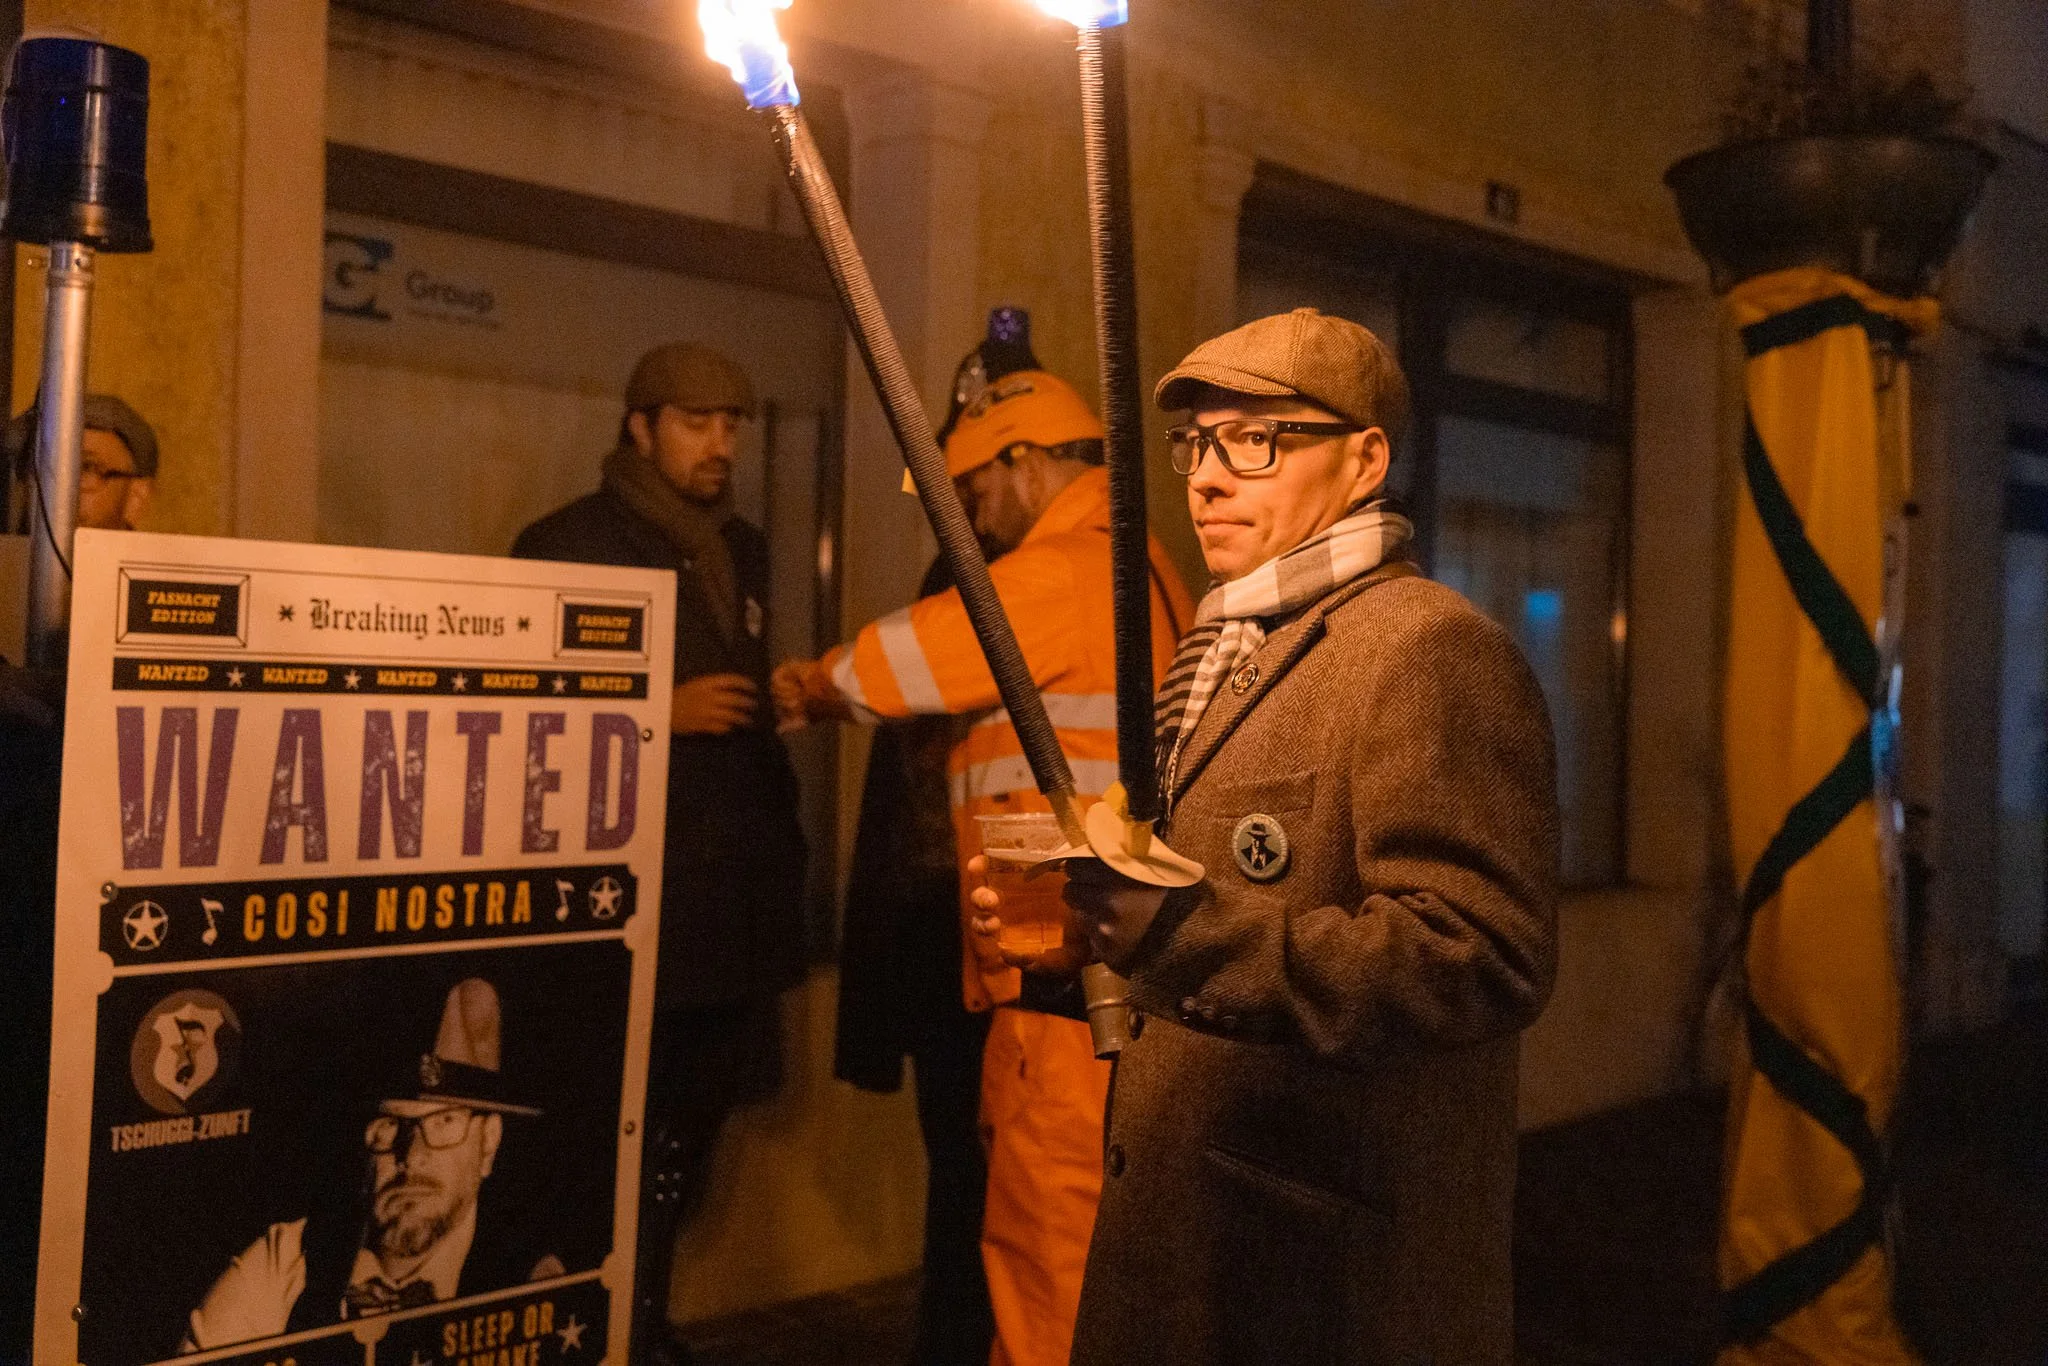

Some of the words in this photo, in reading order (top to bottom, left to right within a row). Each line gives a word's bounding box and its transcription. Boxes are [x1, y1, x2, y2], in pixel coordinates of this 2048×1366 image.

[151, 609, 216, 624] EDITION
[310, 598, 428, 640] Breaking
[437, 605, 505, 637] News
[138, 664, 209, 682] WANTED
[263, 668, 328, 685] WANTED
[376, 670, 438, 687] WANTED
[482, 673, 539, 690] WANTED
[580, 676, 633, 692] WANTED
[116, 706, 640, 870] WANTED
[243, 890, 348, 941] COSI
[375, 881, 531, 932] NOSTRA
[442, 1310, 514, 1357] SLEEP
[524, 1301, 554, 1338] OR
[458, 1340, 541, 1366] AKE
